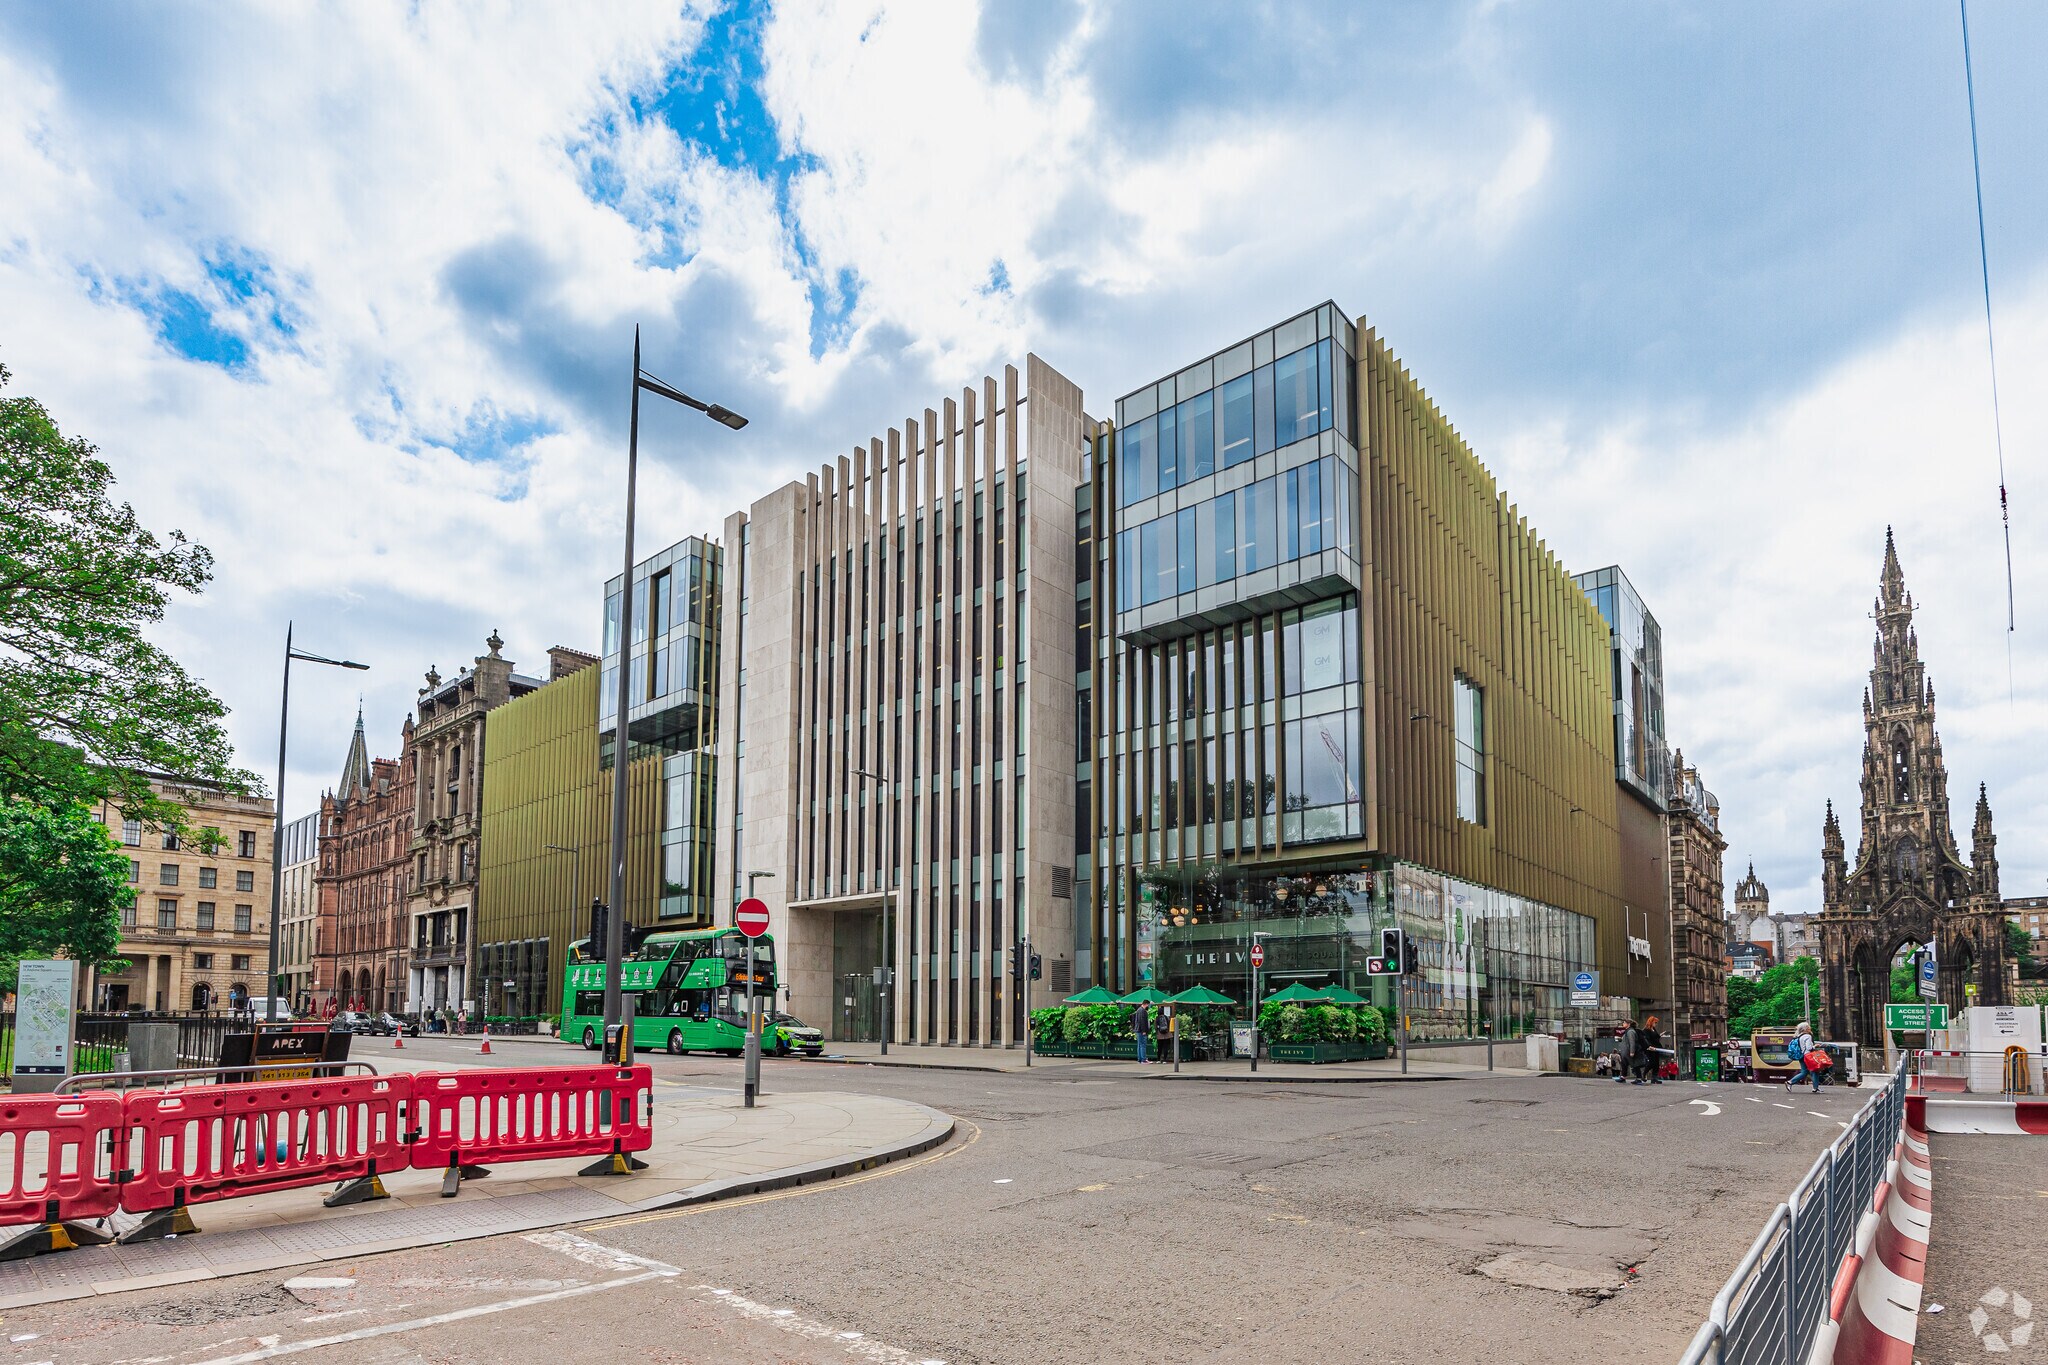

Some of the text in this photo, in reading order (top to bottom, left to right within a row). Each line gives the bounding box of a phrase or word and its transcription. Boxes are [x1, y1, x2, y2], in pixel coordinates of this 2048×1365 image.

[1314, 655, 1330, 666] GM
[1185, 953, 1216, 964] THE
[272, 1038, 304, 1049] APEX
